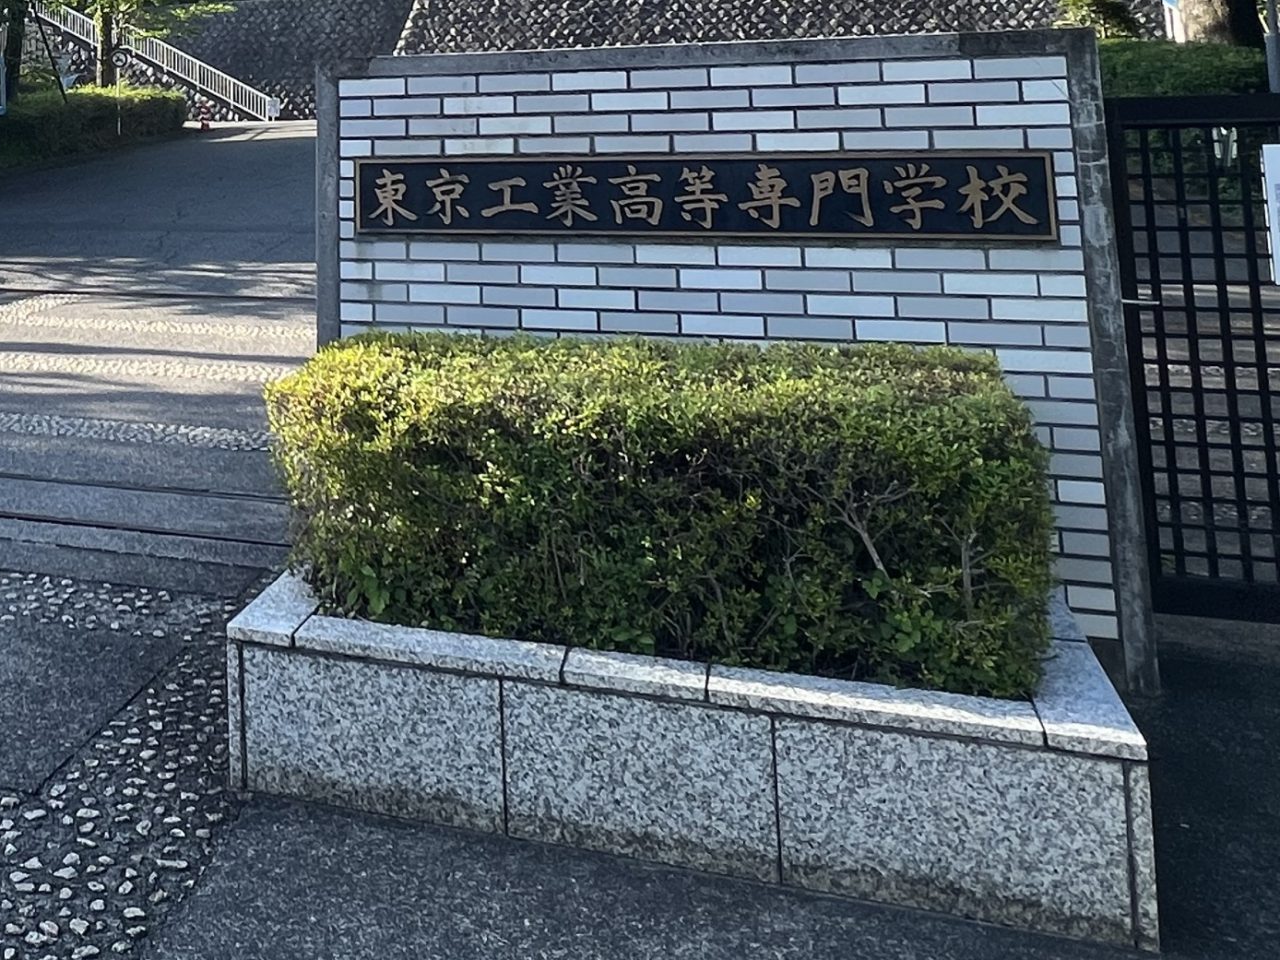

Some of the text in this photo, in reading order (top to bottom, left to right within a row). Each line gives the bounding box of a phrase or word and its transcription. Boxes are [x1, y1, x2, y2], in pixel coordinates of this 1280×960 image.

[368, 163, 1040, 230] 東京工業高等専門学校
